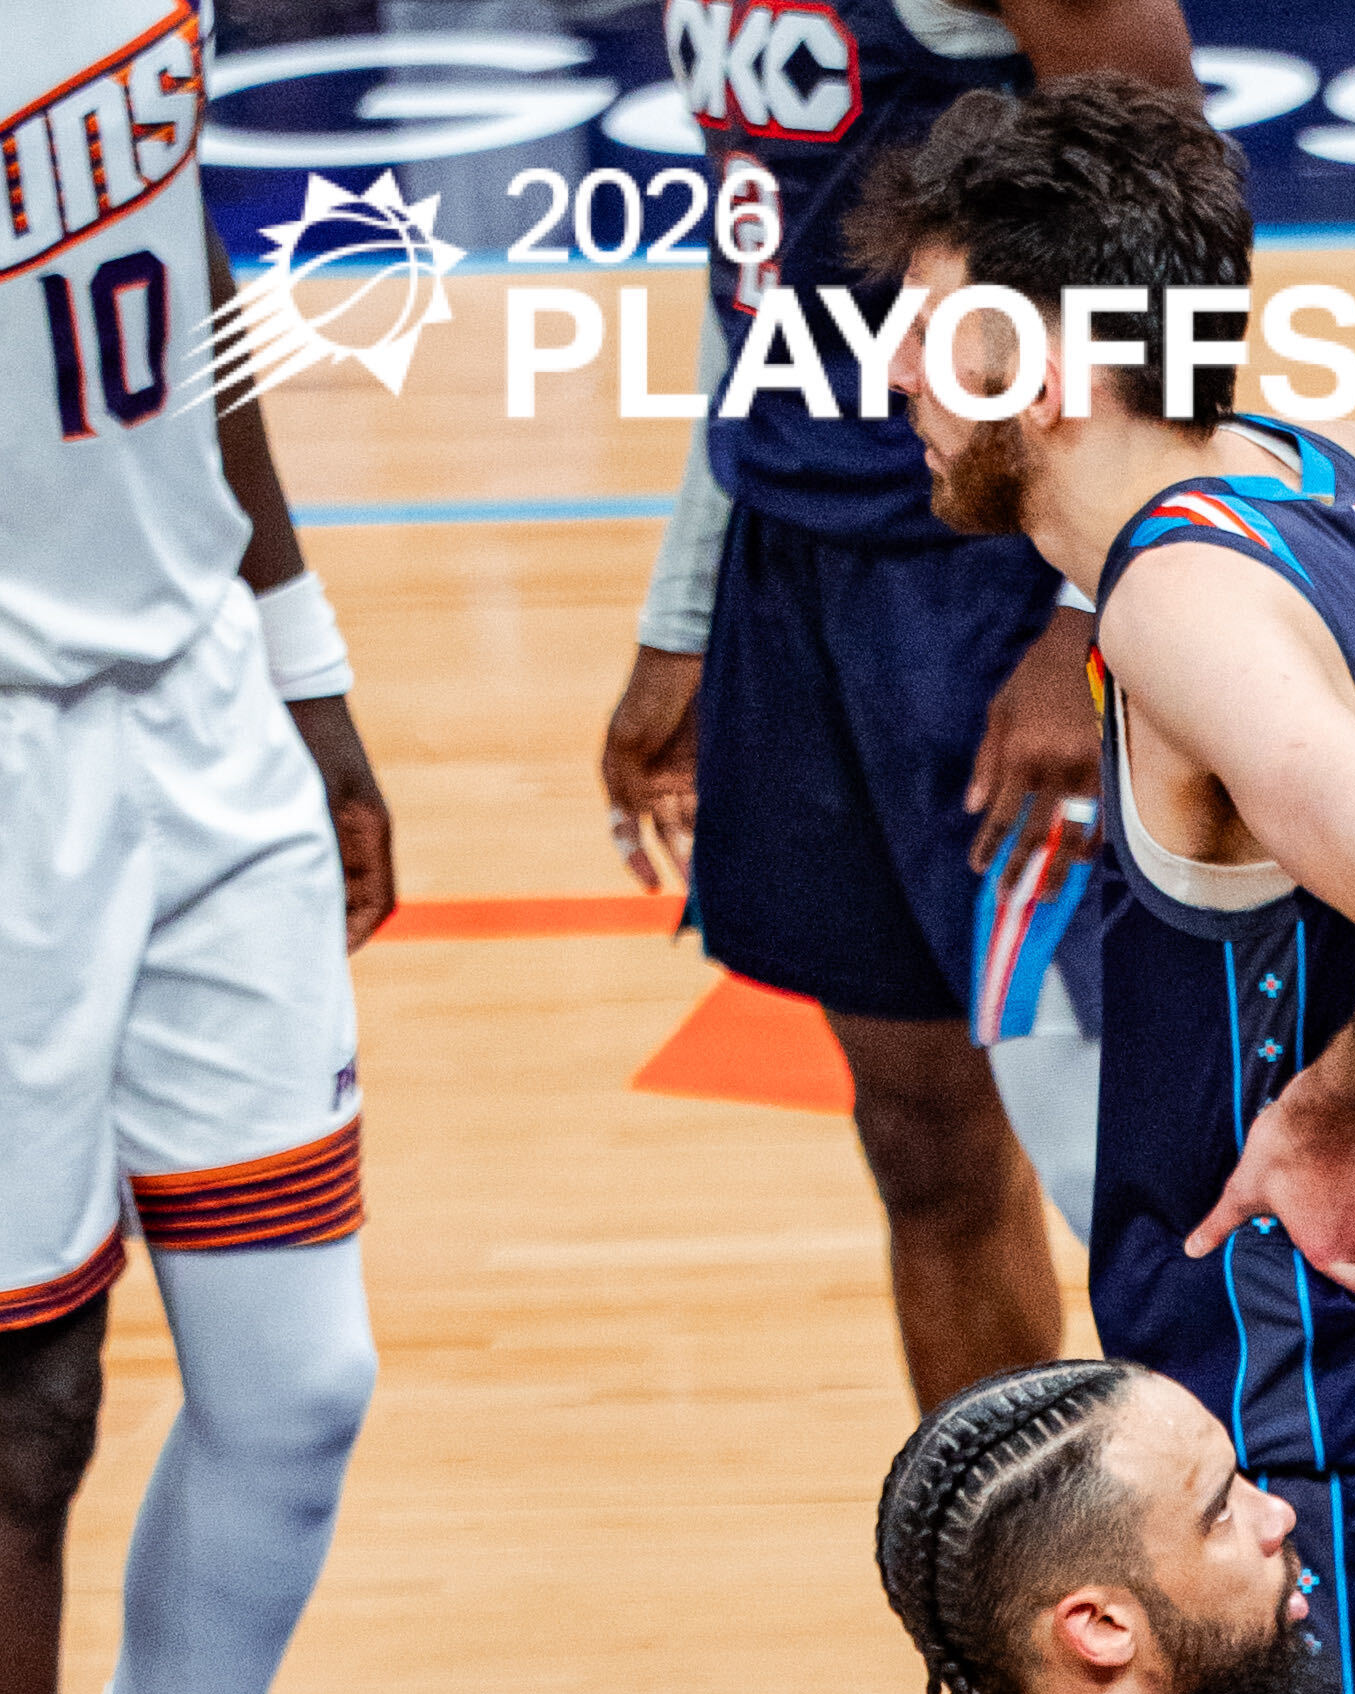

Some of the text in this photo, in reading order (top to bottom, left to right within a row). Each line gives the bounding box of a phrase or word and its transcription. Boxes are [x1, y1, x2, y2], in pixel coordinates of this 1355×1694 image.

[0, 36, 202, 268] UNS
[658, 0, 861, 143] OKC
[39, 249, 169, 442] 10
